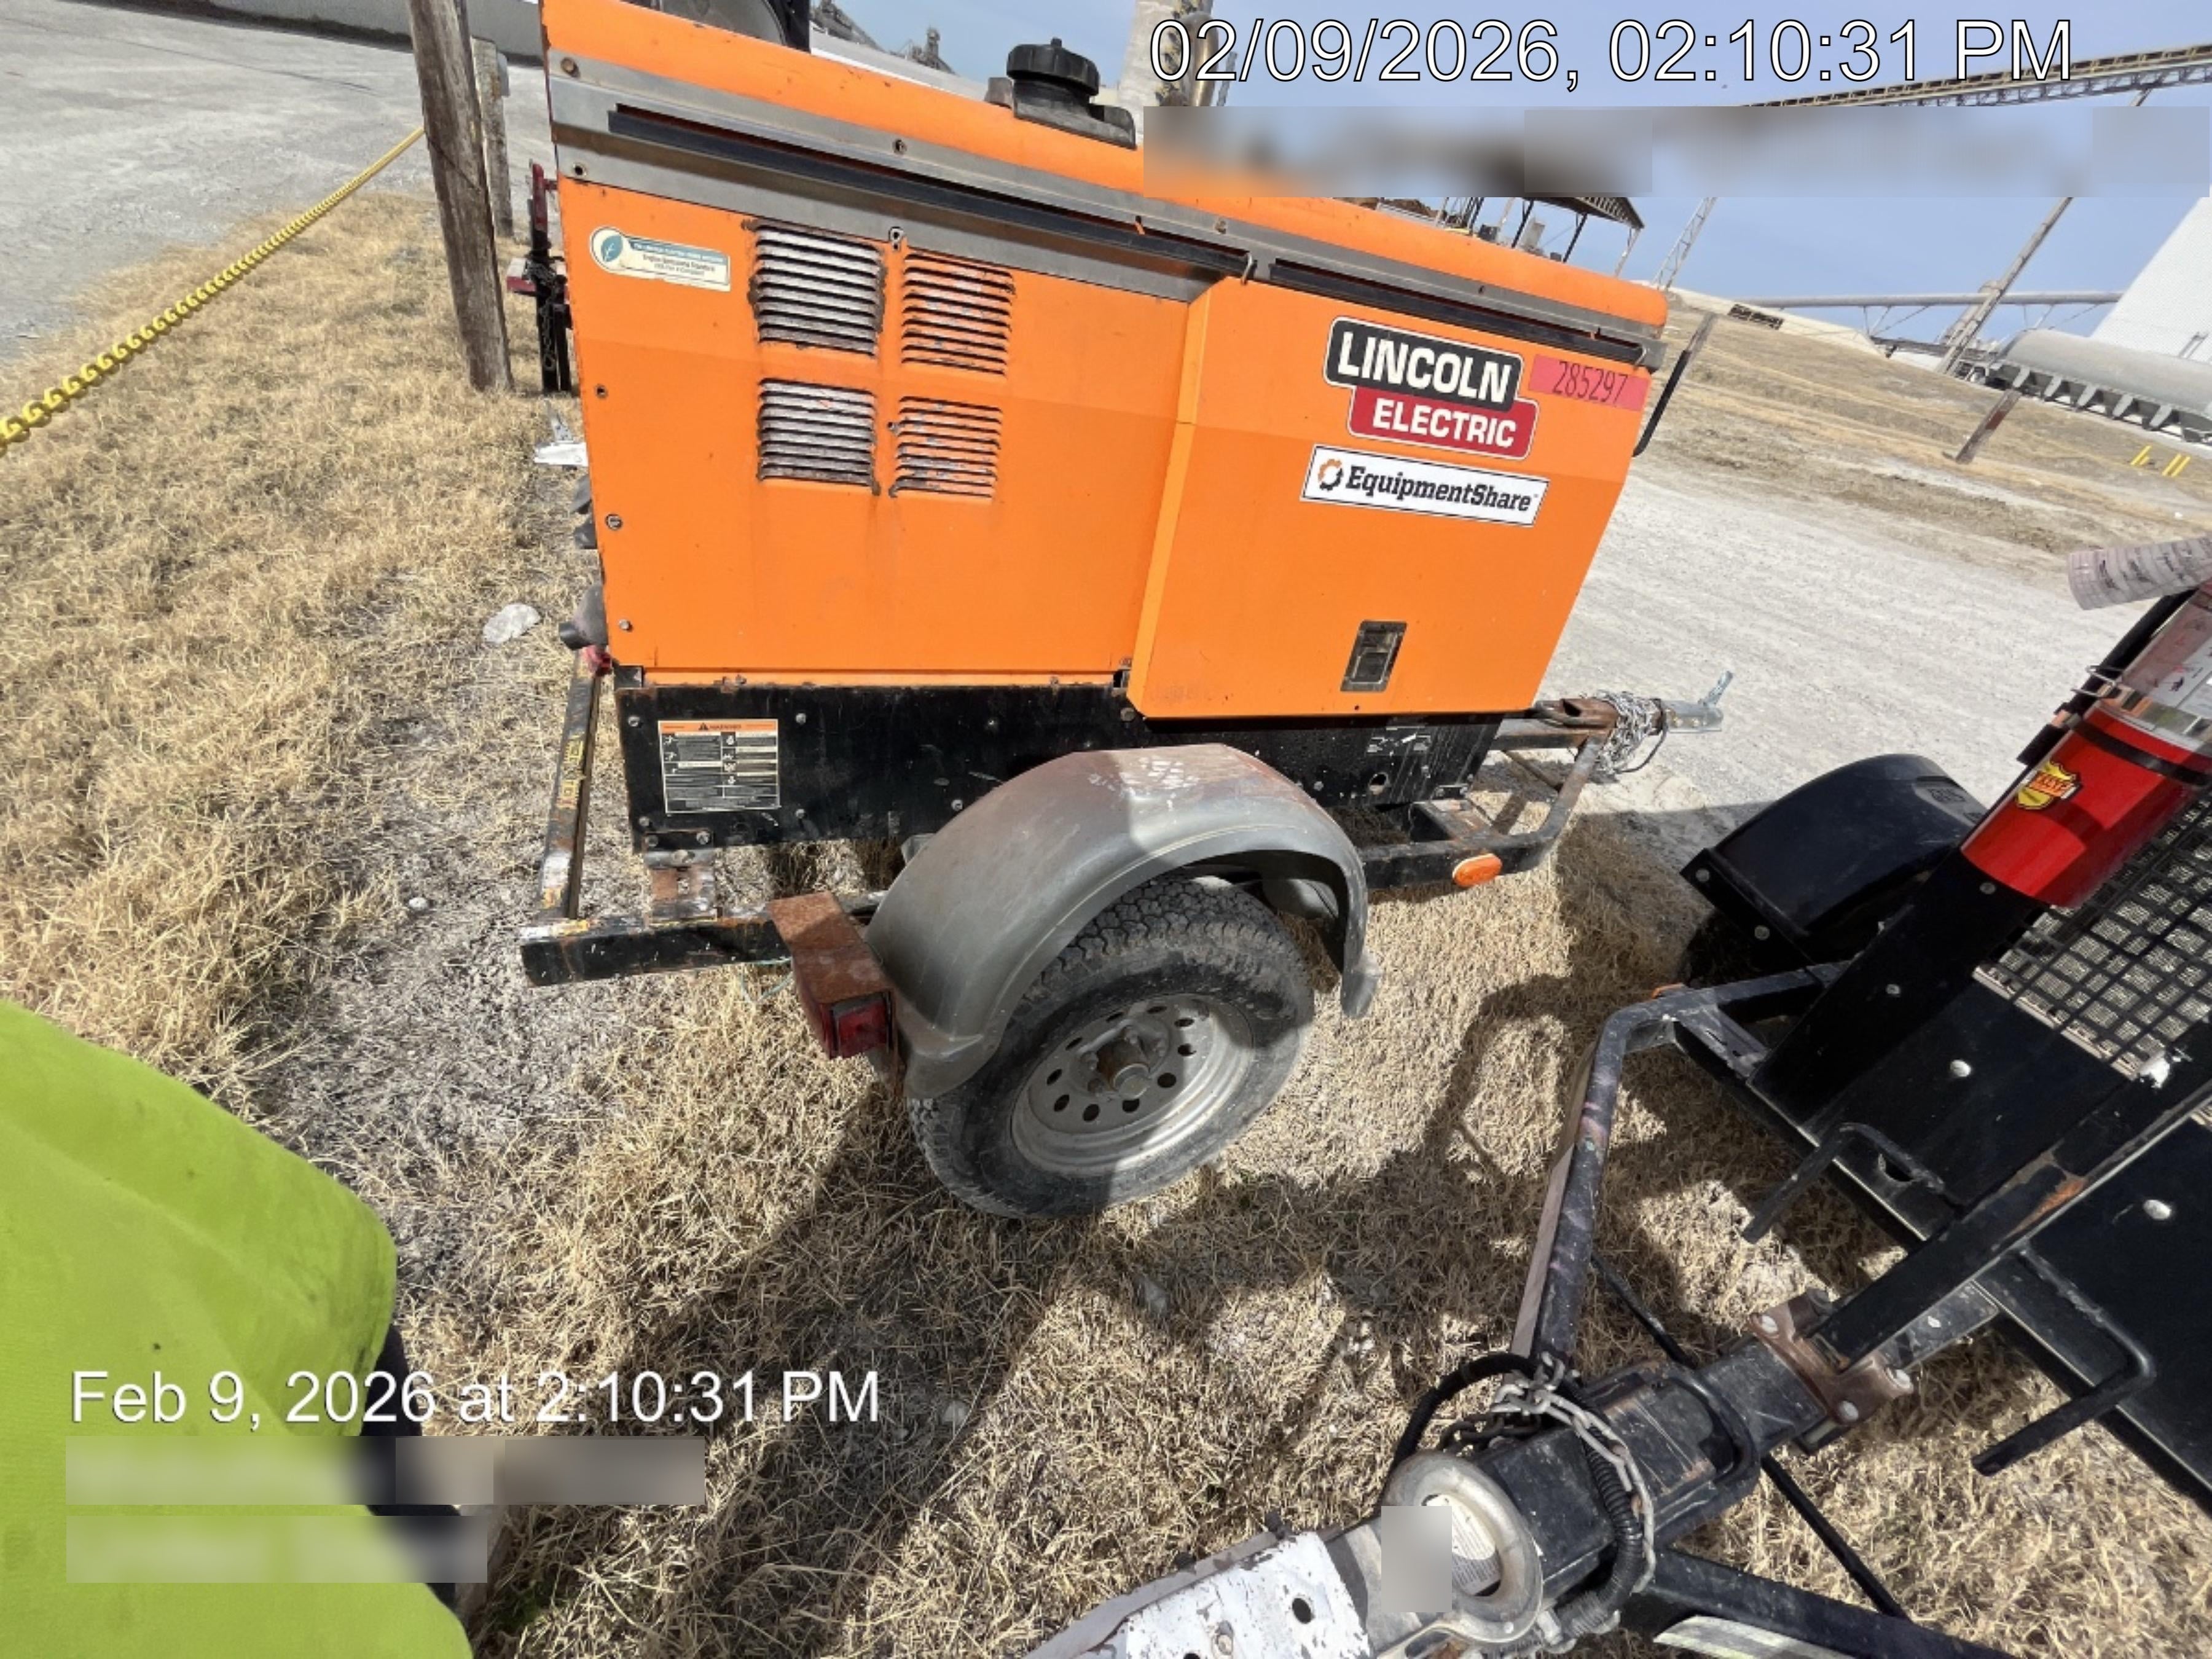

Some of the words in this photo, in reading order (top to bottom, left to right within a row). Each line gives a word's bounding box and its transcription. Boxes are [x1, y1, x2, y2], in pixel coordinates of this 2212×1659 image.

[1338, 331, 1512, 403] LINCOLN
[1552, 361, 1628, 406] 285297
[1373, 398, 1516, 448] ELECTRIC
[1345, 465, 1532, 512] EquipmentShare
